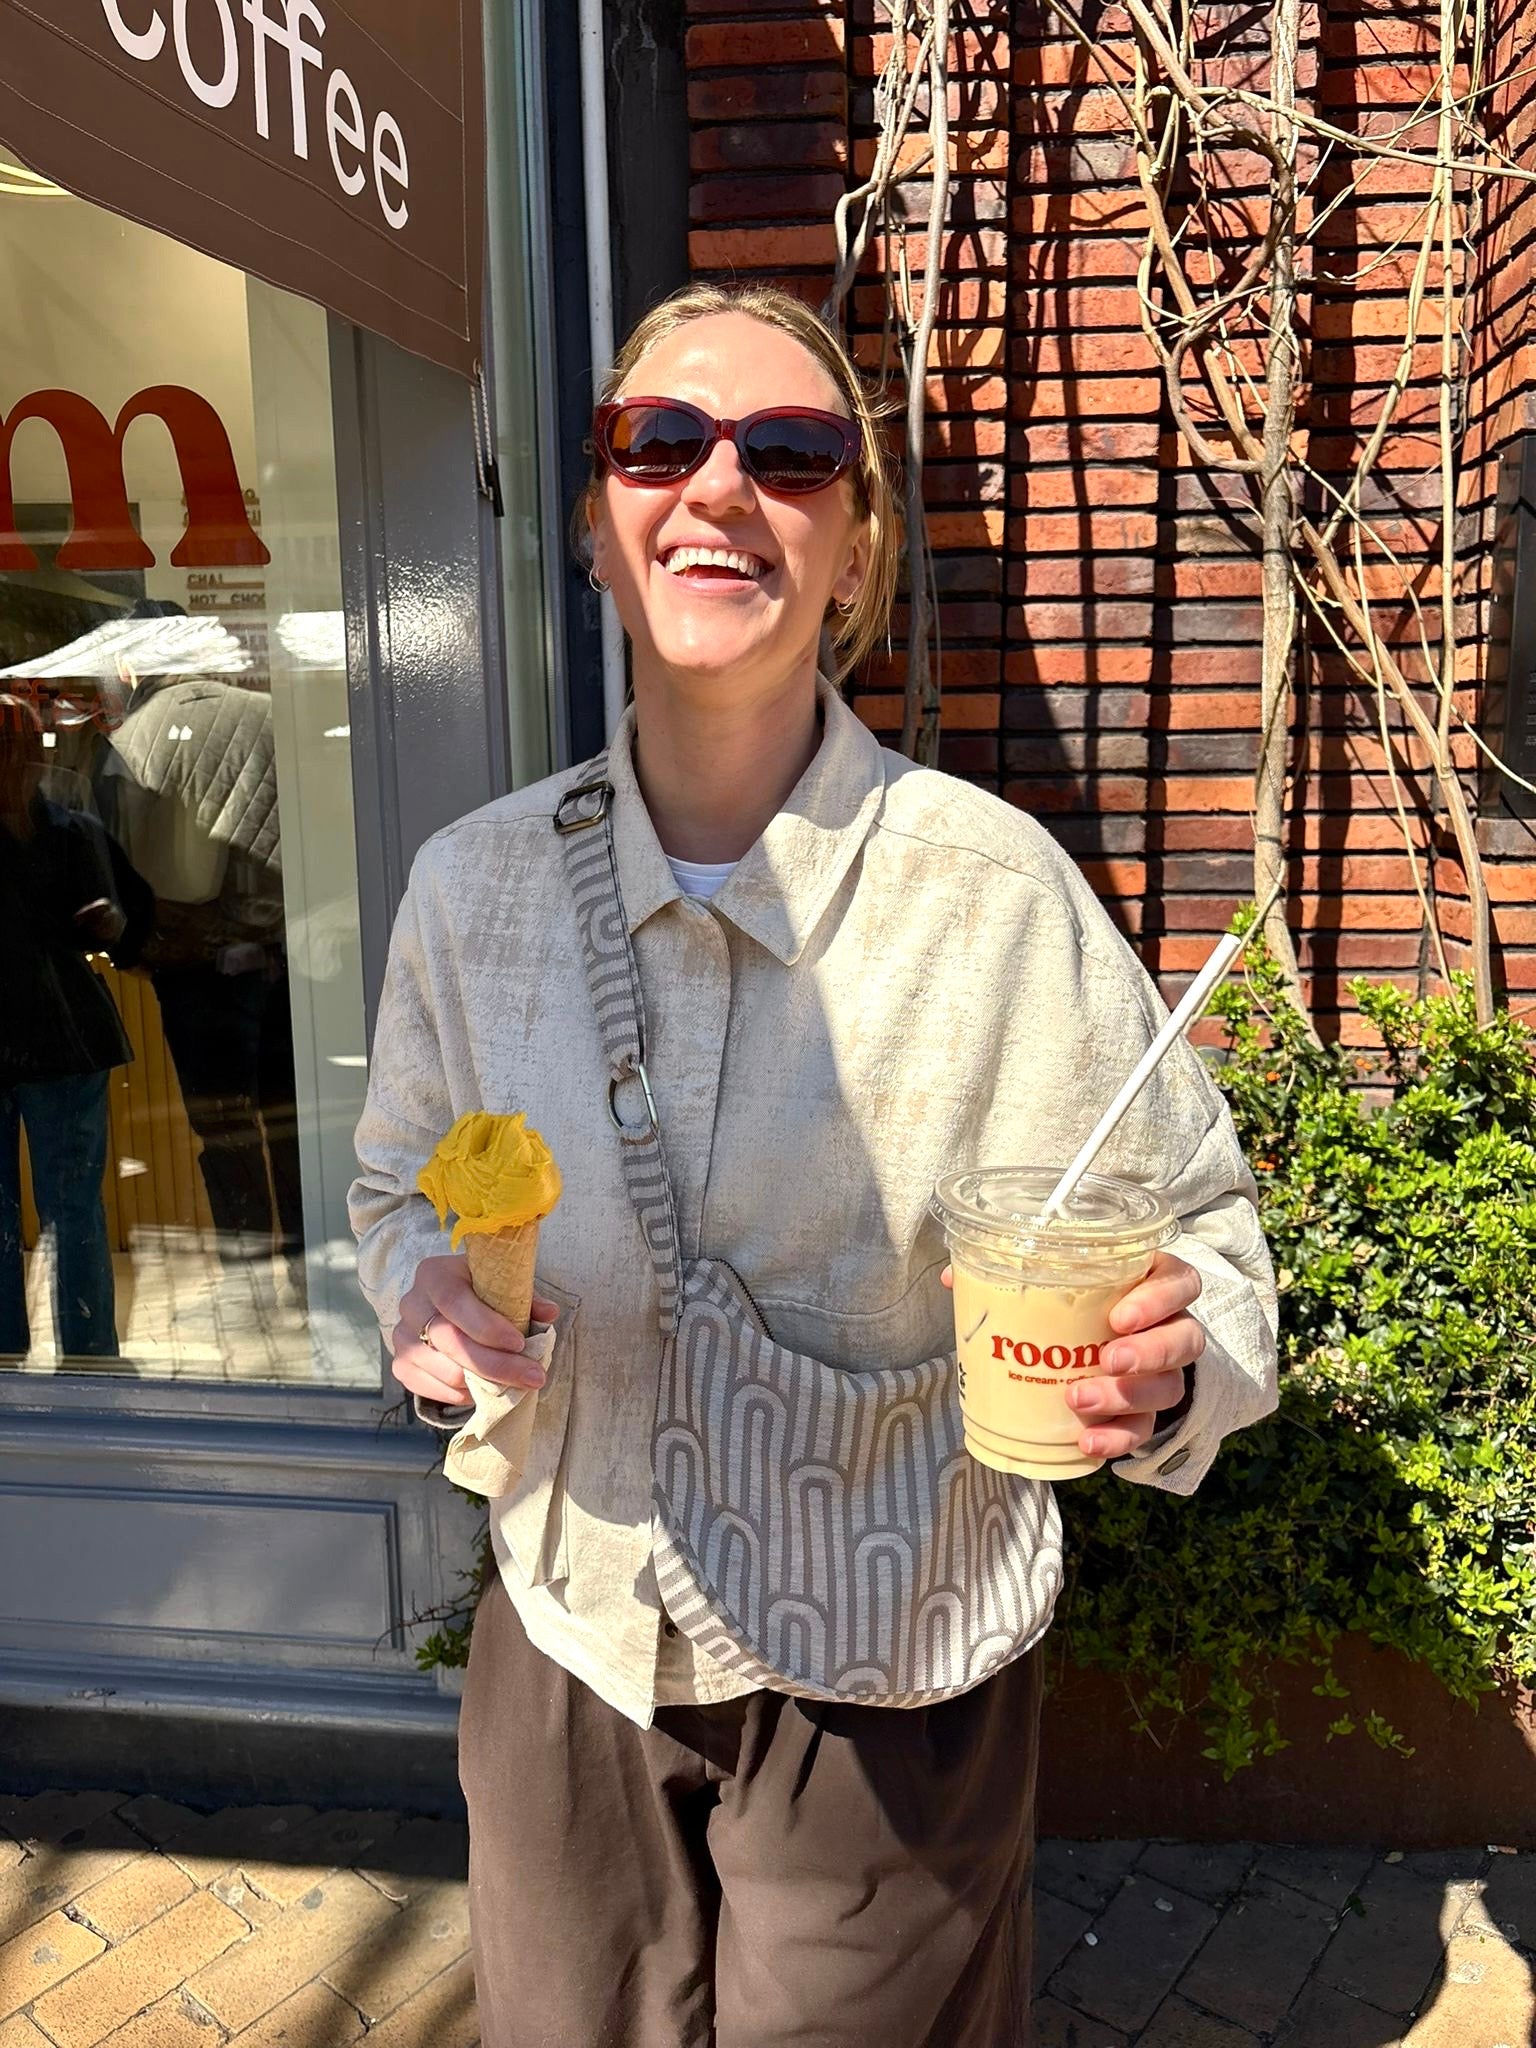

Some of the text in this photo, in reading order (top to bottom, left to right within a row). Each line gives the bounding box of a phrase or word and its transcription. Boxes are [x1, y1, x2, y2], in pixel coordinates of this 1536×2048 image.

[0, 677, 124, 733] ffee
[1008, 1370, 1023, 1382] ice
[1024, 1375, 1058, 1385] cream
